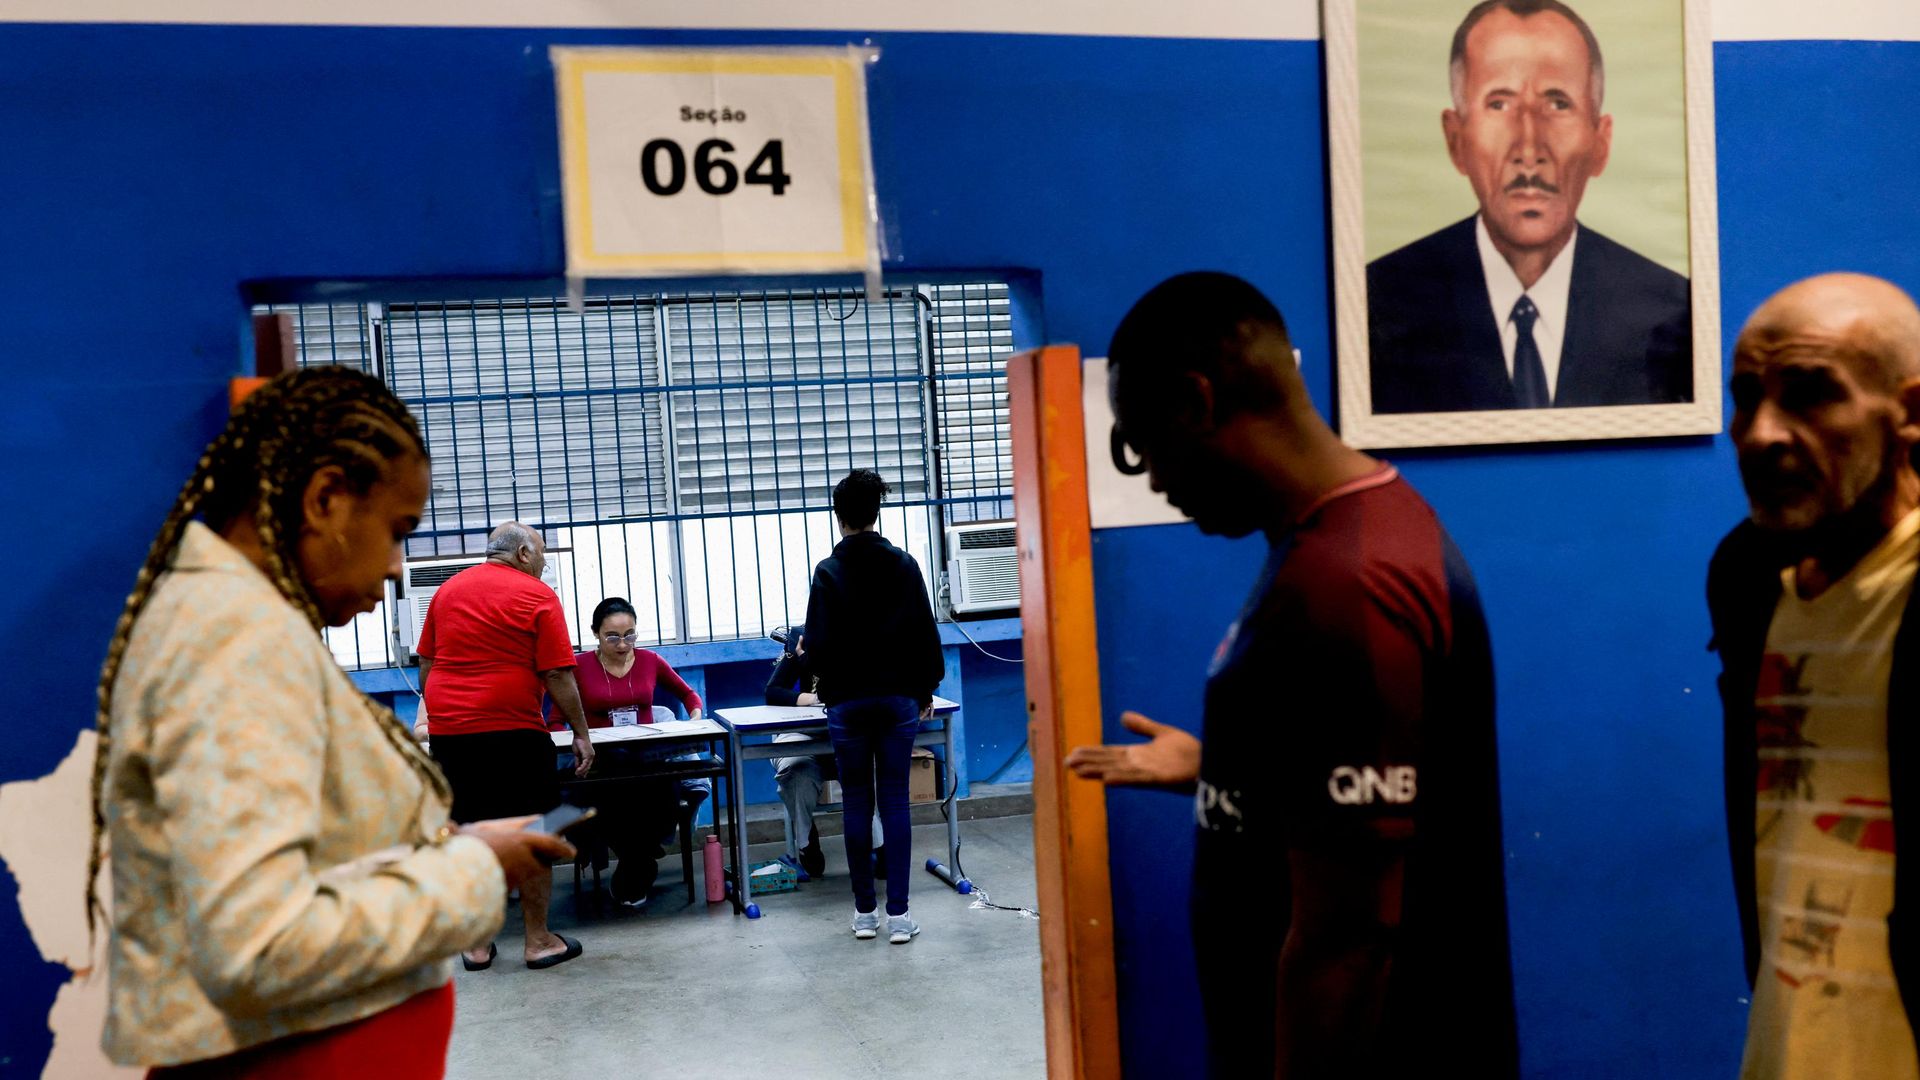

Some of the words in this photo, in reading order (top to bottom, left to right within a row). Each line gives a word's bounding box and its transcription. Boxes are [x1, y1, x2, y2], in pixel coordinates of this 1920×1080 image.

[680, 105, 746, 124] Seção
[640, 138, 791, 196] 064
[1328, 765, 1417, 805] QNB
